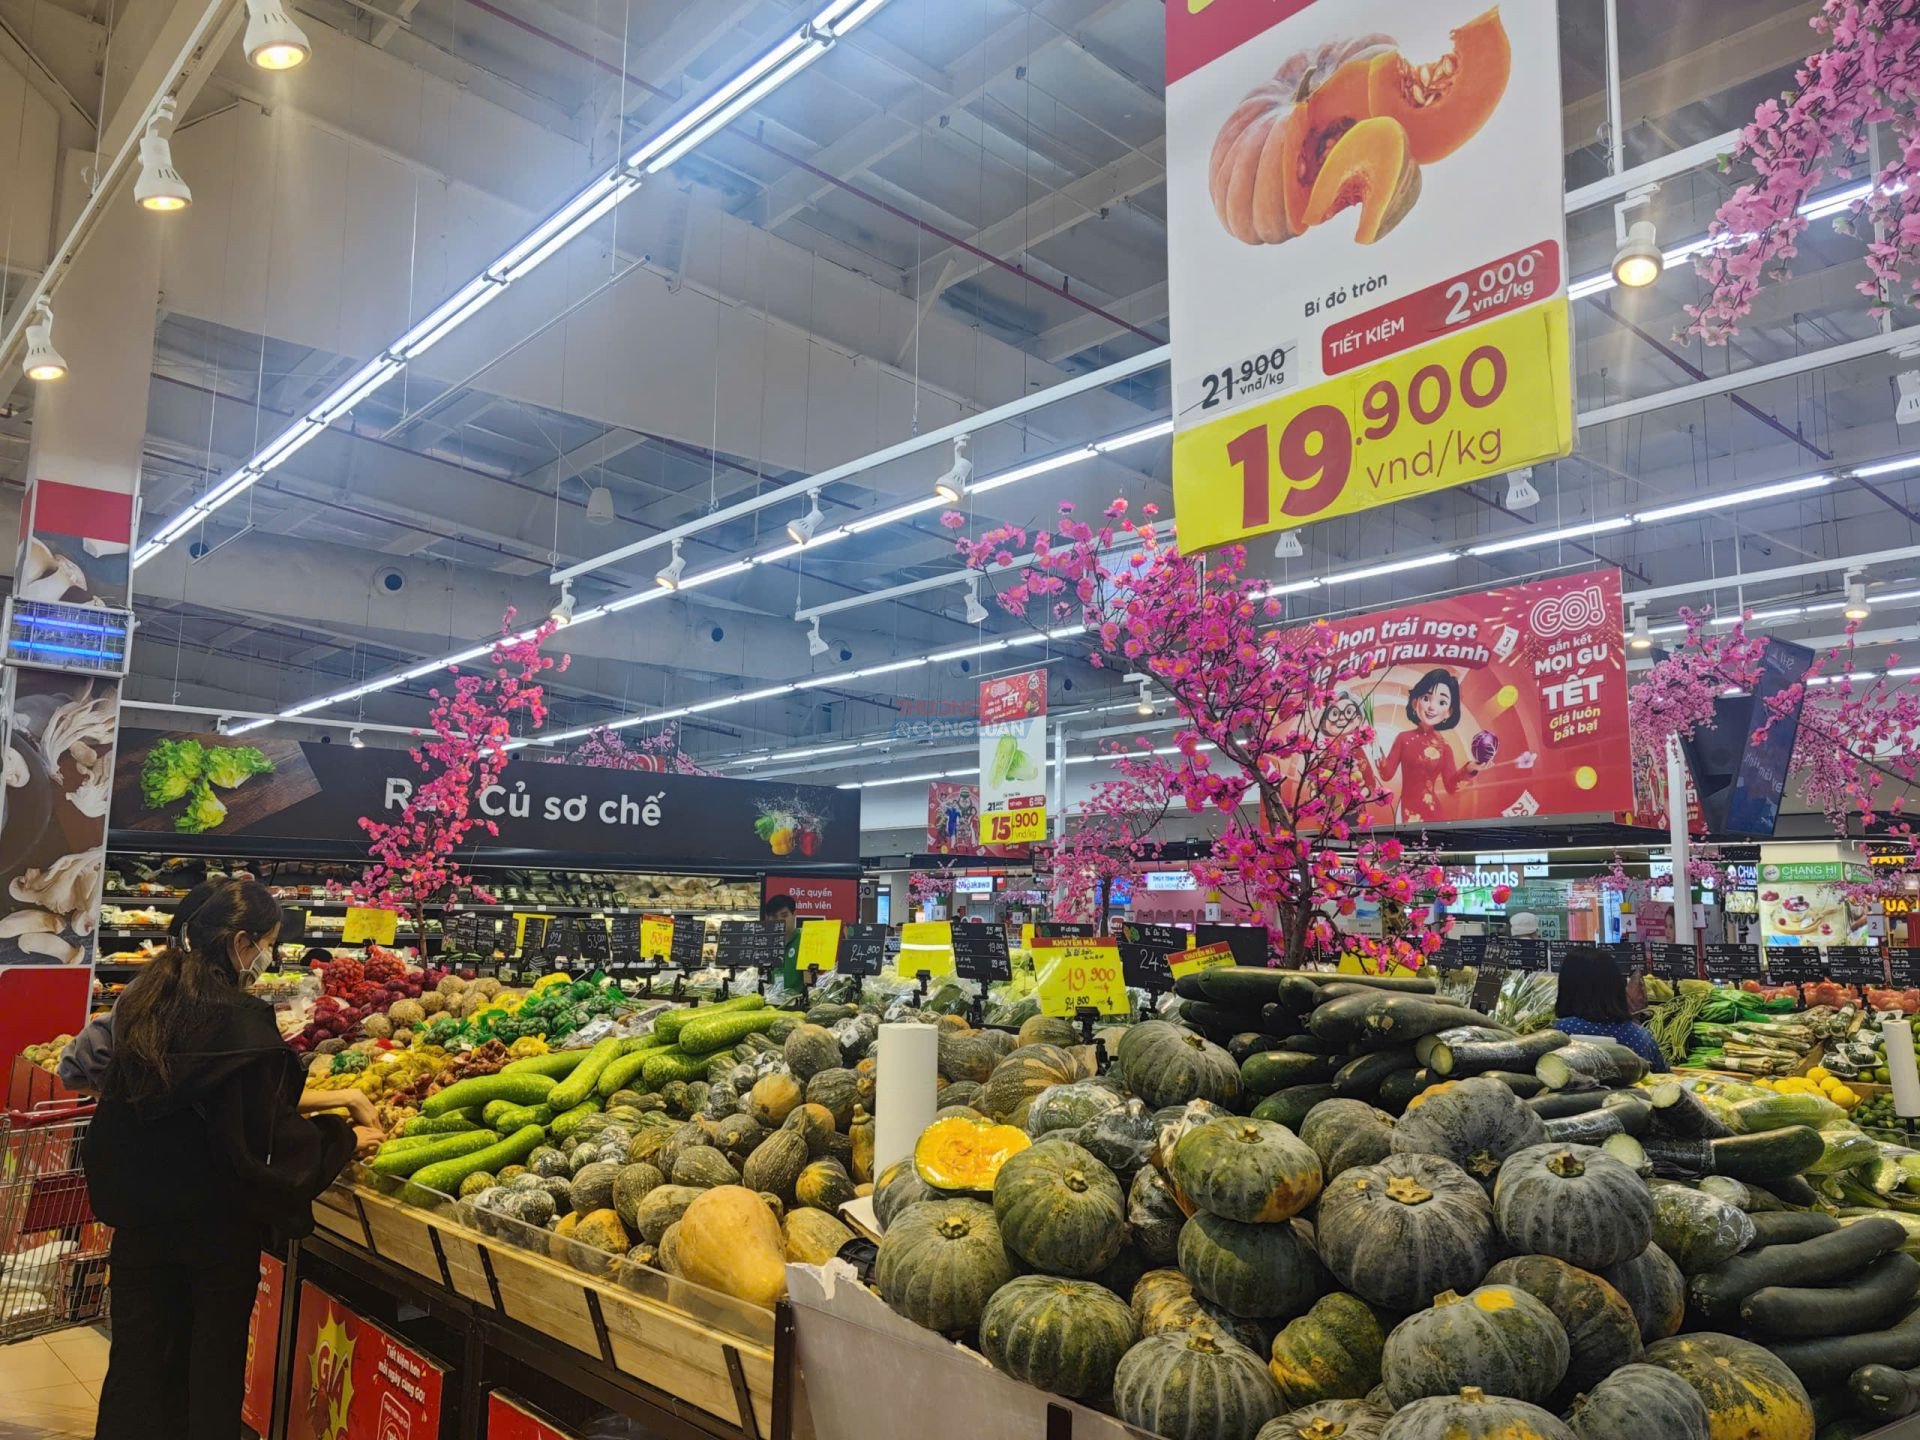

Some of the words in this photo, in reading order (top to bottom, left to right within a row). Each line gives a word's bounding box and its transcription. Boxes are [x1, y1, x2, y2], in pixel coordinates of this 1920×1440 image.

[1304, 298, 1322, 318] Bí
[1325, 287, 1347, 310] đỏ
[1351, 273, 1388, 304] tròn
[1472, 279, 1534, 315] vnđ/kg
[1329, 328, 1363, 360] TIẾT
[1365, 316, 1405, 343] KIỆM
[1201, 347, 1287, 411] 21.900
[1239, 369, 1286, 397] vnđ/kg
[1226, 344, 1508, 530] 19.900
[1530, 585, 1606, 637] GO!
[1381, 616, 1419, 640] trái
[1422, 619, 1478, 642] ngọt
[1573, 633, 1592, 648] kết
[1391, 643, 1430, 662] rau
[1432, 642, 1489, 663] xanh
[1535, 653, 1572, 676] MỌI
[1577, 643, 1608, 665] GU
[1542, 668, 1604, 711] TẾT
[1550, 713, 1570, 730] Giá
[1572, 706, 1600, 722] luôn
[1554, 724, 1575, 743] bất
[1578, 718, 1598, 735] bại
[480, 780, 530, 818] Củ
[543, 794, 588, 822] sơ
[599, 791, 666, 826] chế
[992, 811, 1038, 840] 15.900
[1738, 864, 1757, 878] CHAN
[1782, 865, 1822, 876] CHANG
[789, 887, 805, 899] Đặc
